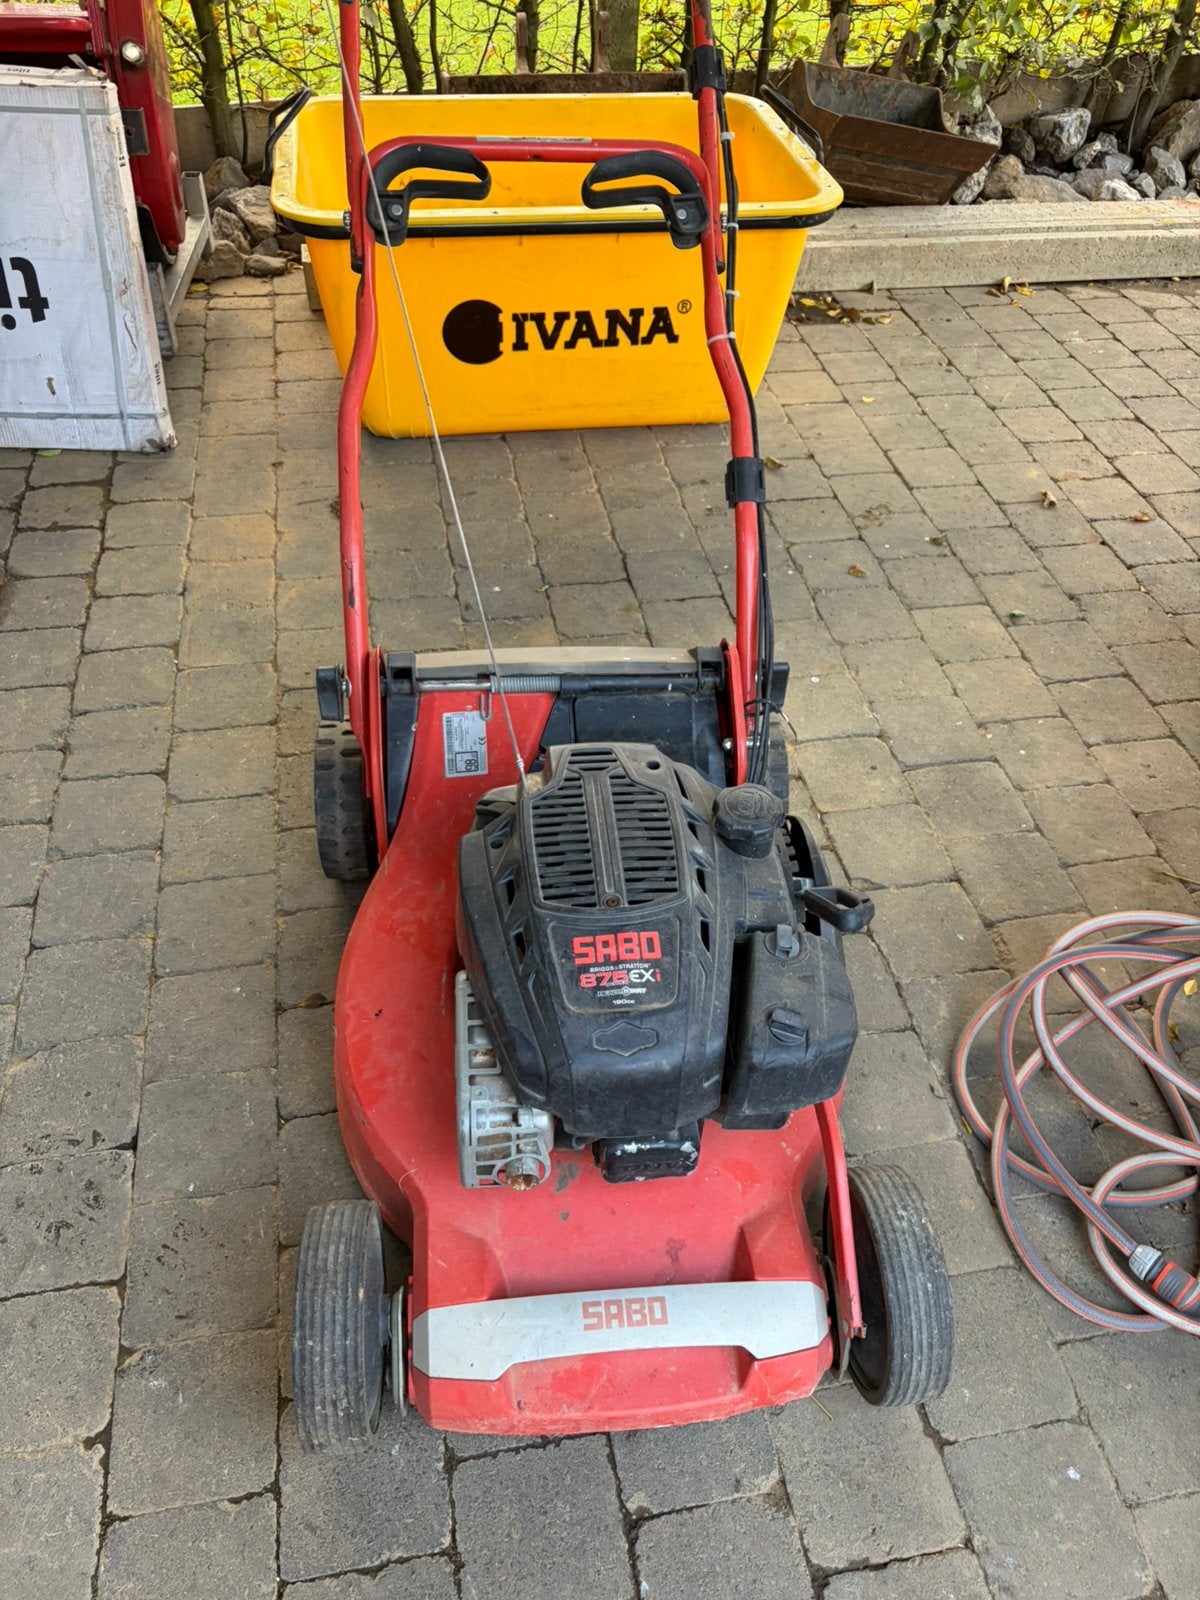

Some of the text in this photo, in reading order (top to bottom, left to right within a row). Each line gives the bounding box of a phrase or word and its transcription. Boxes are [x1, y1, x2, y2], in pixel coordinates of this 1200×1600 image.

[572, 931, 662, 965] SABO
[590, 964, 615, 973] BRIGGS
[582, 1296, 668, 1331] SABO
